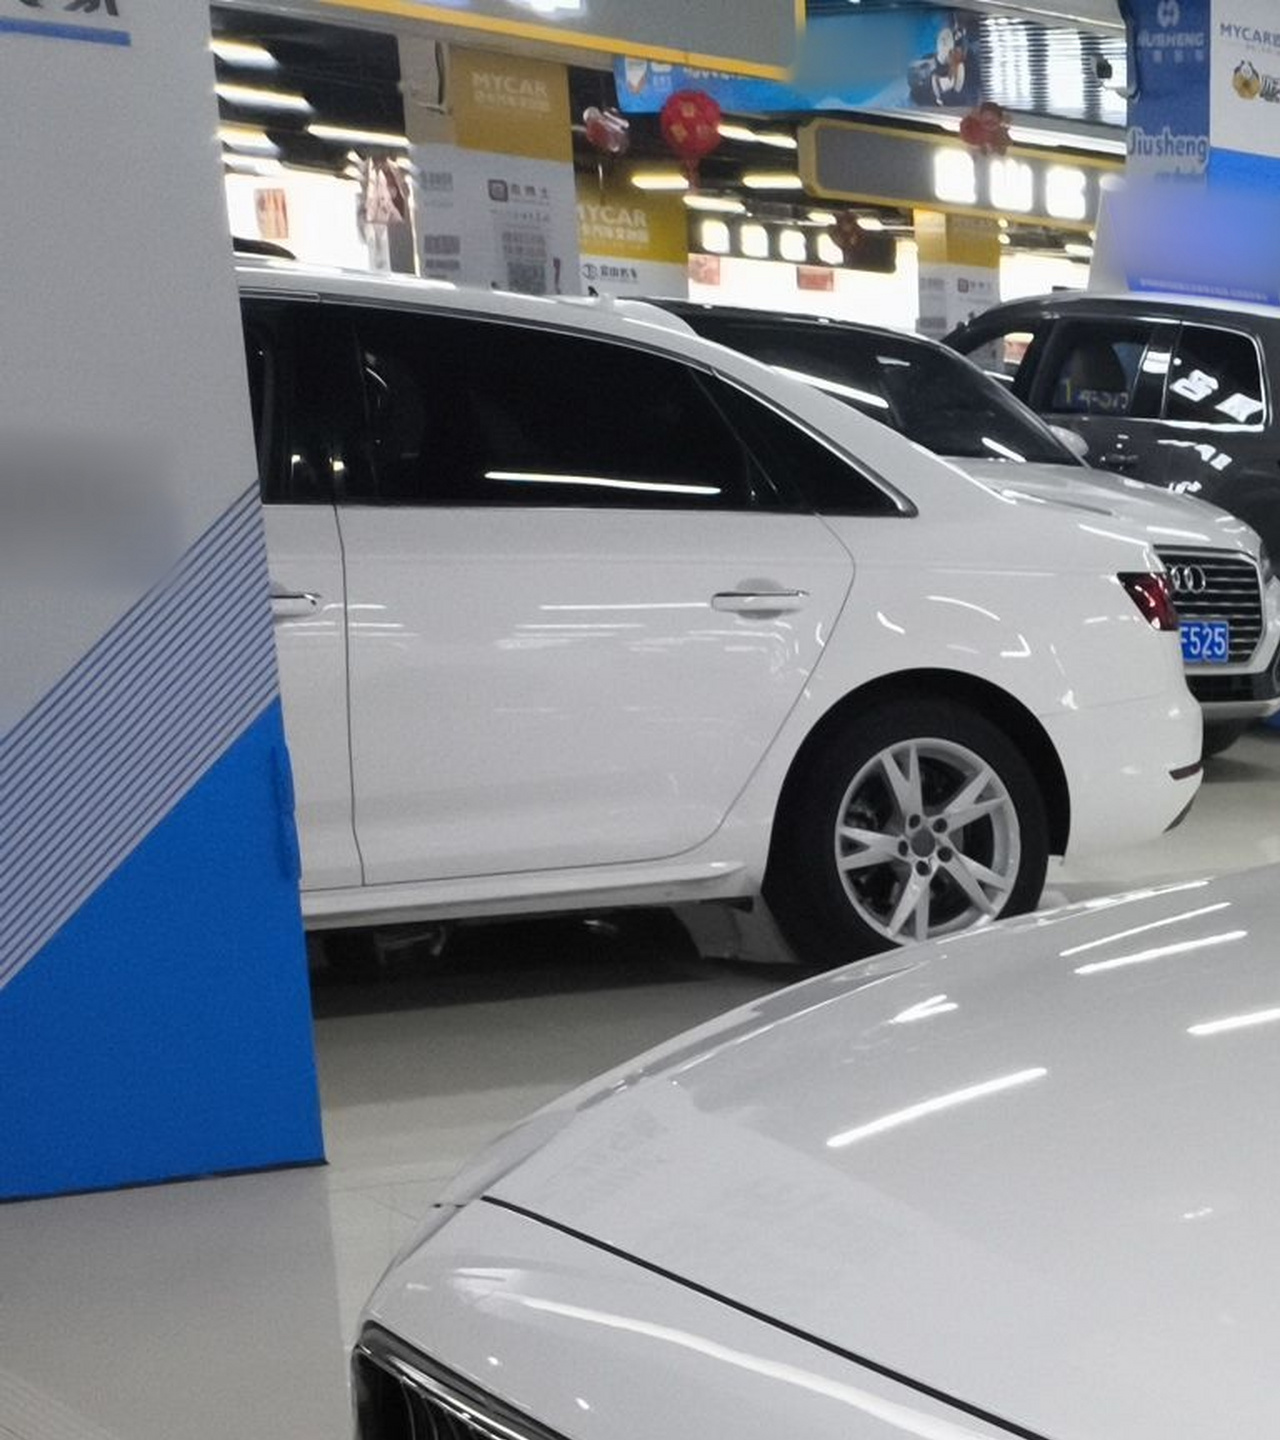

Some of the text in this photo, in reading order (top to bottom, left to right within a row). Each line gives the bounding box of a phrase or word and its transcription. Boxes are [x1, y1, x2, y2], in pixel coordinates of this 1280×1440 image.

[1220, 23, 1273, 47] MYCAR
[472, 72, 549, 97] MYCAR
[1127, 128, 1208, 164] Jiusheng
